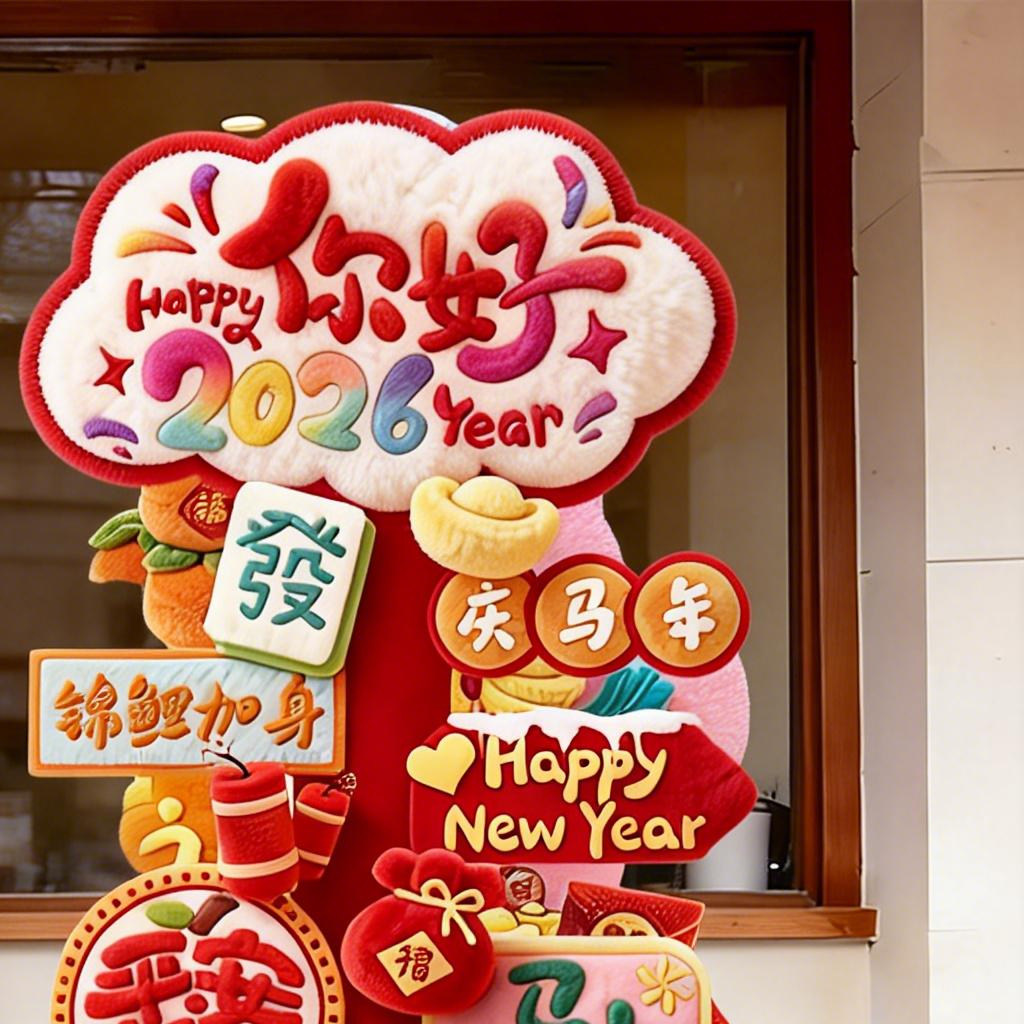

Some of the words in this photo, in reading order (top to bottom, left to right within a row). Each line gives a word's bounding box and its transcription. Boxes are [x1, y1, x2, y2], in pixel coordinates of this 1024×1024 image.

[221, 157, 627, 383] 你好
[125, 277, 264, 351] Happy
[141, 327, 434, 455] 2026
[433, 382, 563, 449] Year
[236, 509, 347, 631] 發
[456, 575, 716, 652] 庆马年
[54, 671, 325, 750] 锦鲤加身
[484, 734, 667, 805] Happy
[443, 803, 566, 853] New
[579, 800, 706, 860] Year
